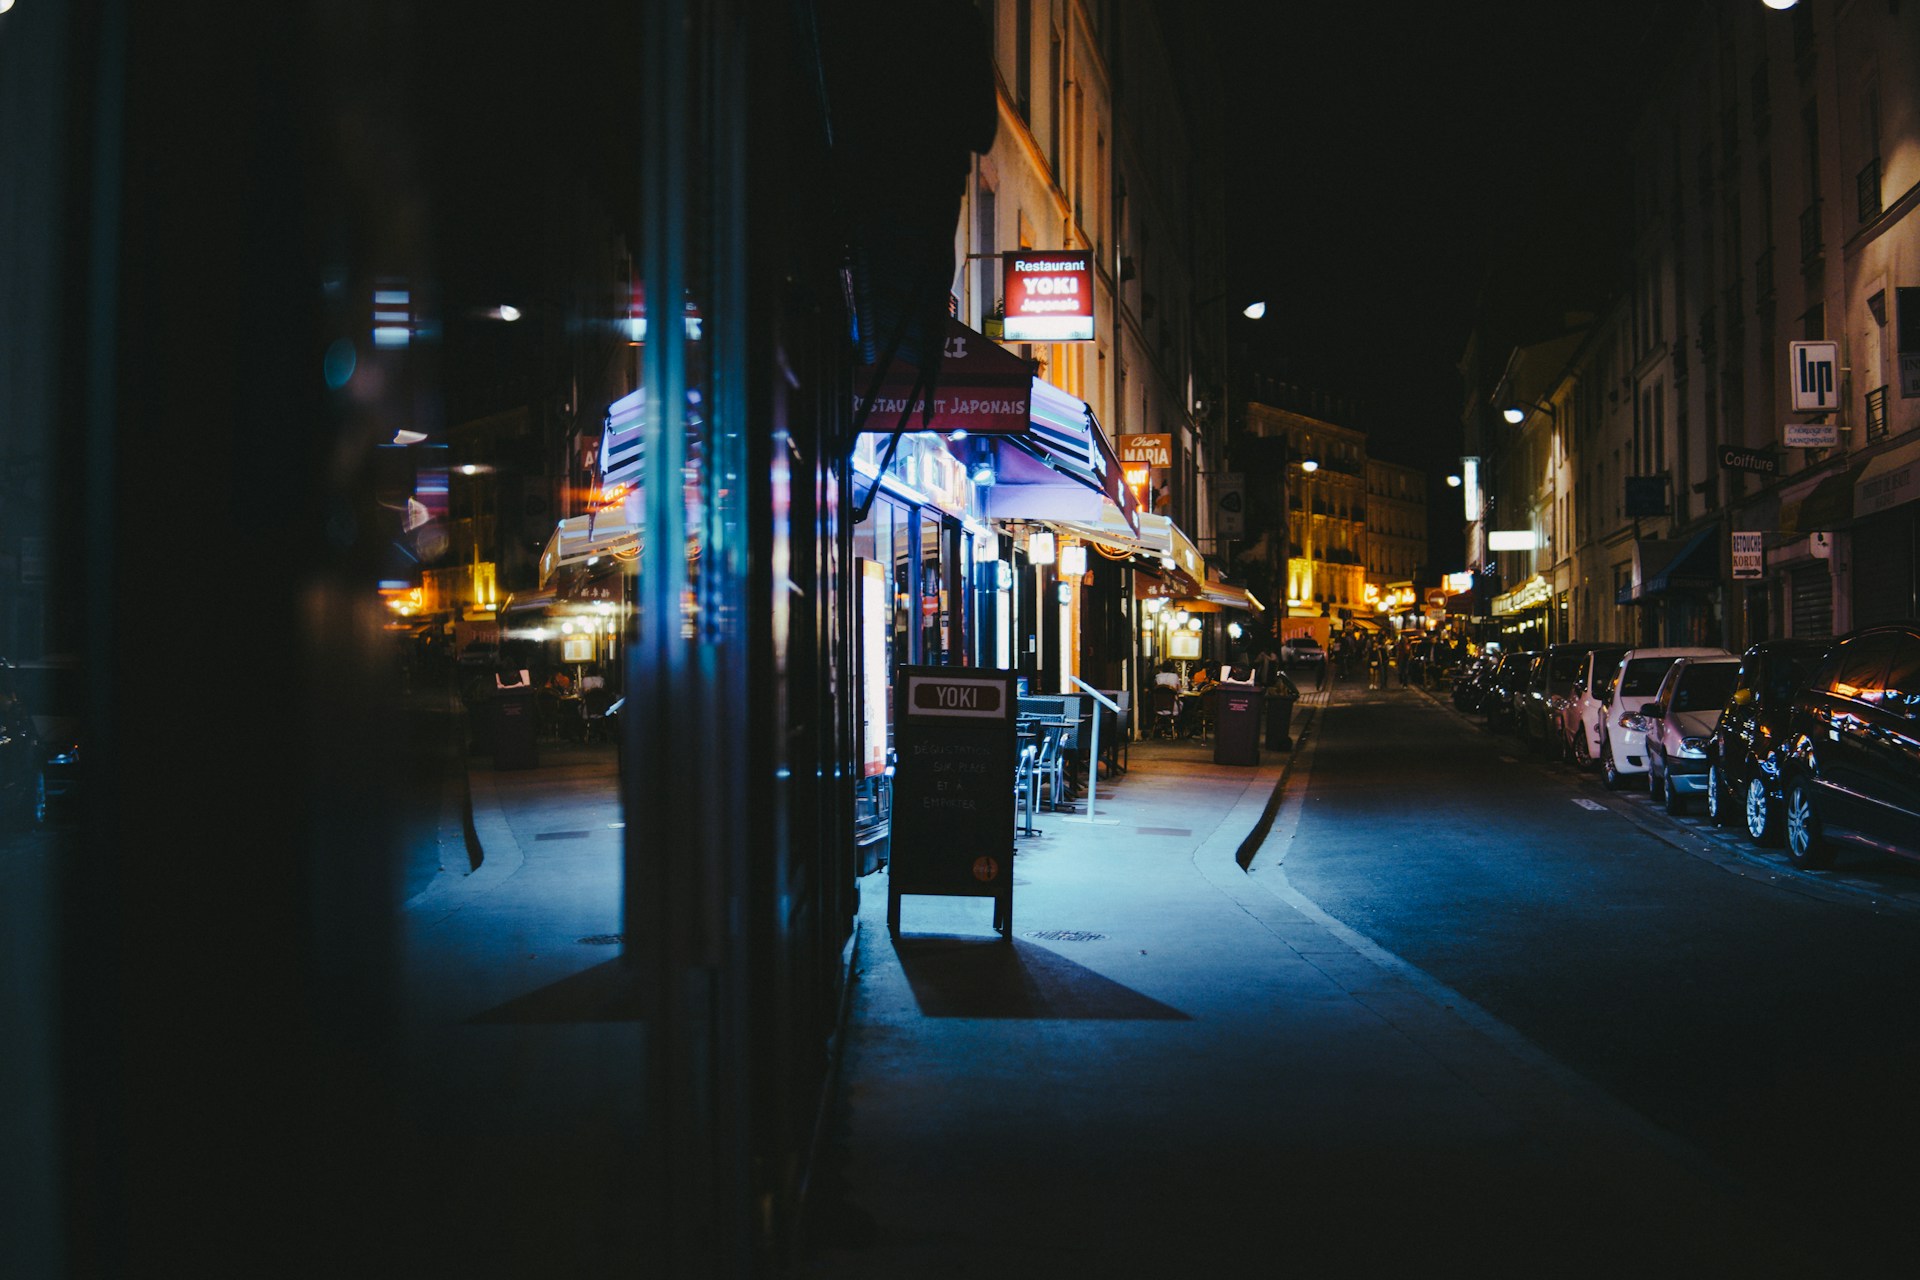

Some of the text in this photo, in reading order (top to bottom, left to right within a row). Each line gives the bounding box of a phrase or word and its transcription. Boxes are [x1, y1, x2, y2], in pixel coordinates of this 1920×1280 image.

[1015, 260, 1085, 272] Restaurant
[1023, 277, 1078, 295] YOKI
[951, 397, 1025, 415] JAPONAIS
[1124, 448, 1169, 465] MARIA
[1725, 451, 1774, 471] Coiffure
[1734, 555, 1761, 567] KORUM
[936, 686, 977, 708] YOKI
[937, 781, 948, 791] ET
